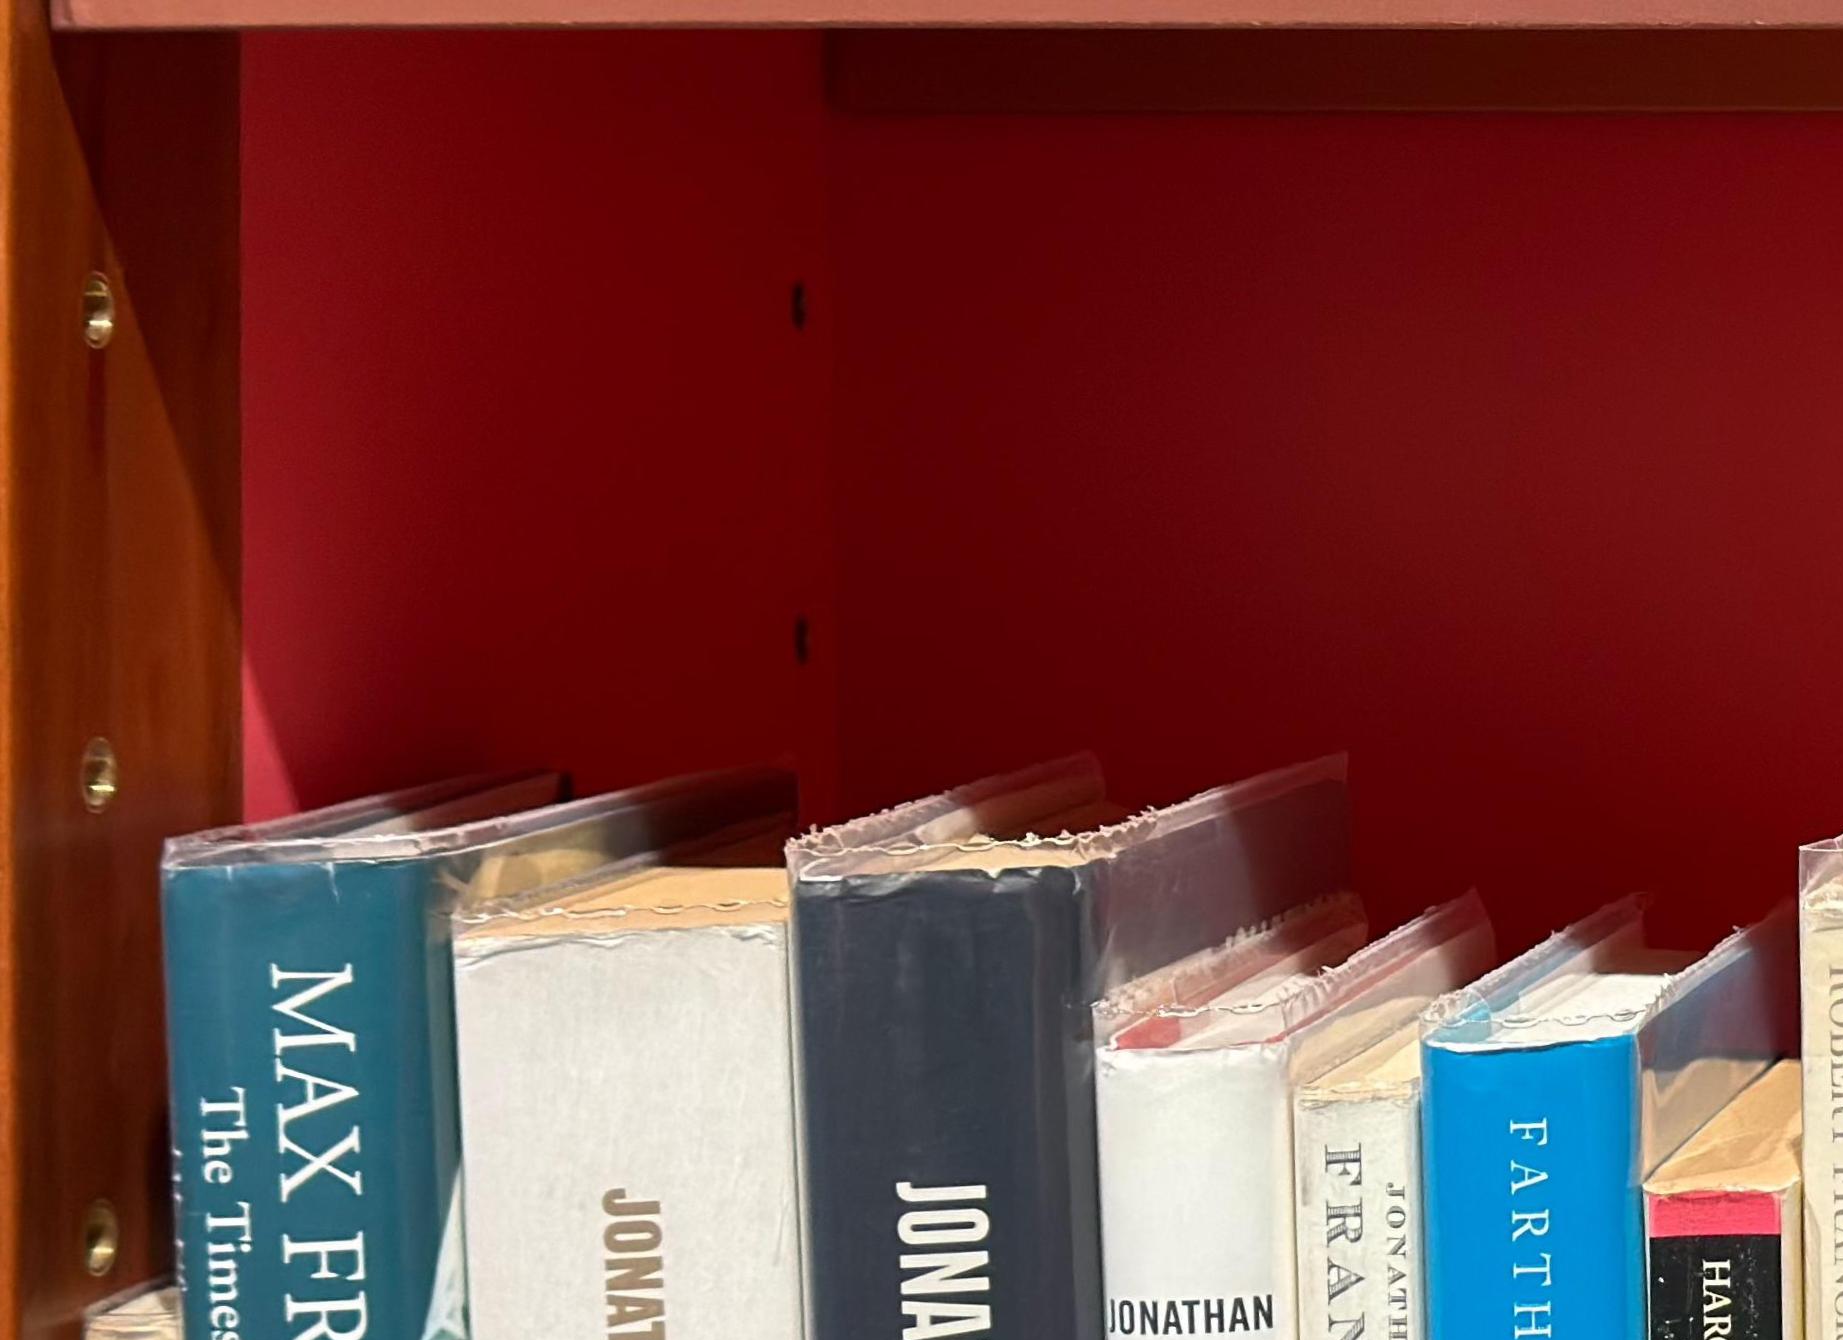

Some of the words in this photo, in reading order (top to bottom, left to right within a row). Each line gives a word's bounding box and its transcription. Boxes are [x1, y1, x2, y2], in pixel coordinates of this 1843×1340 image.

[271, 963, 362, 1202] MAX
[201, 1087, 250, 1184] The
[1110, 1294, 1273, 1335] JONATHAN
